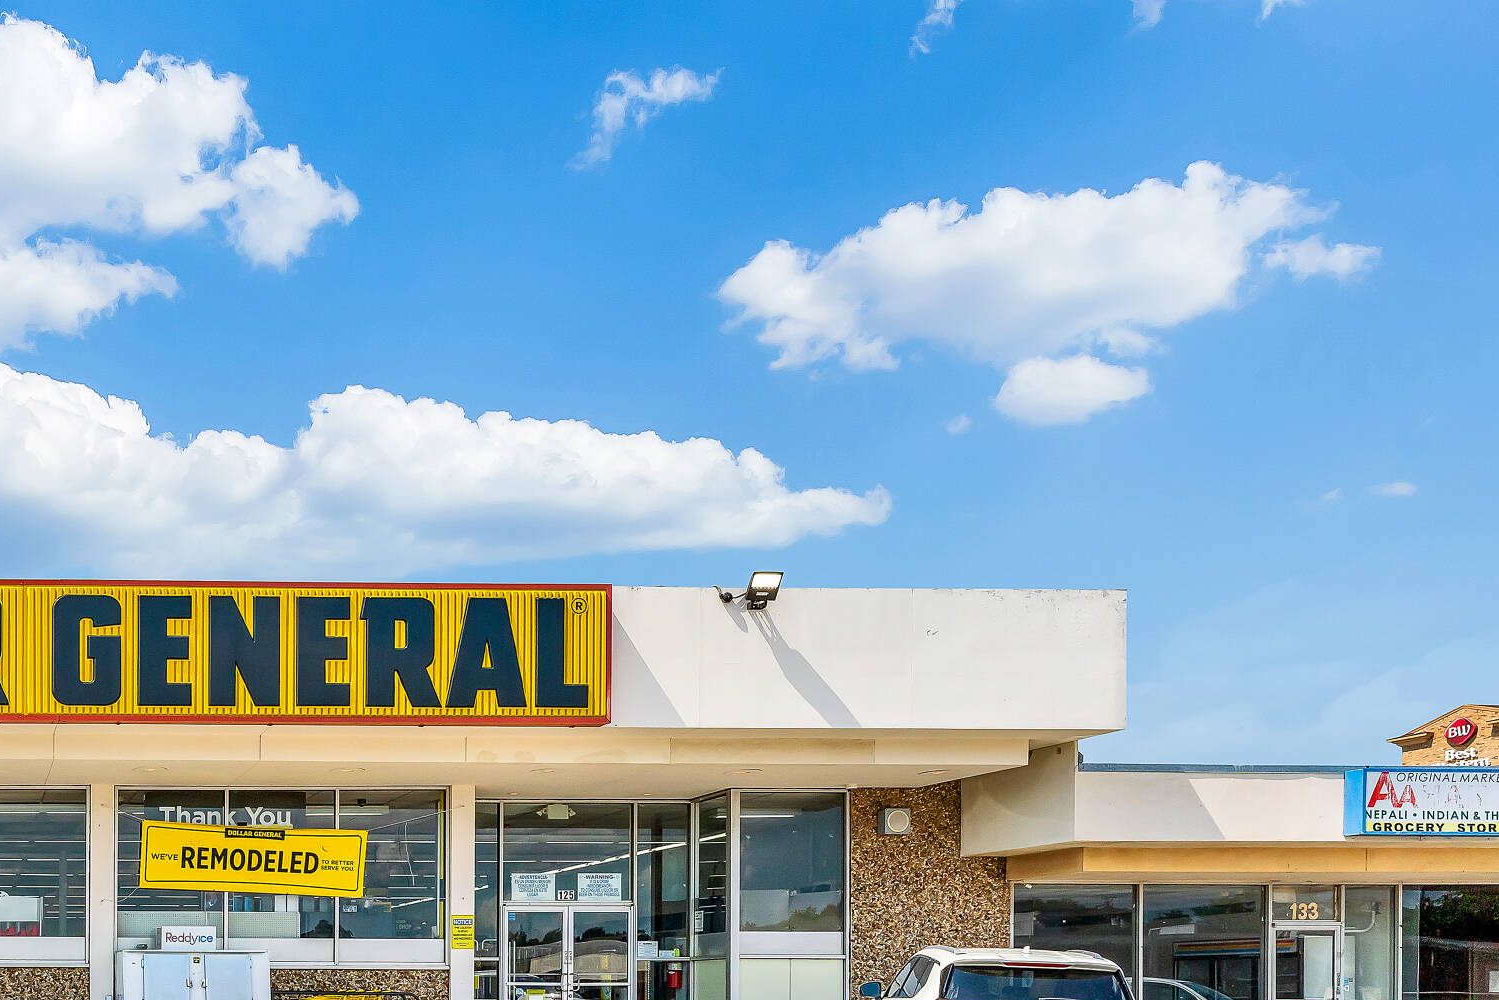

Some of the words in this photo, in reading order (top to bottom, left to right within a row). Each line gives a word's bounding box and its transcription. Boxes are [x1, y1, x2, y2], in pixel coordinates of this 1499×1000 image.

[52, 593, 589, 708] GENERAL
[1448, 724, 1471, 738] BW
[1445, 748, 1477, 761] Best
[1396, 772, 1457, 783] ORIGINAL
[159, 806, 237, 827] Thank
[245, 806, 293, 827] You
[1366, 810, 1408, 820] NEPALI
[1423, 811, 1469, 820] INDIAN
[1473, 811, 1481, 820] &
[227, 830, 253, 838] DOLLAR
[254, 831, 283, 839] GENERAL
[1373, 823, 1445, 832] GROCERY
[1458, 824, 1497, 833] STOR
[151, 852, 179, 861] WE'VE
[181, 846, 320, 875] REMODELED
[558, 891, 574, 900] 125
[1290, 902, 1319, 920] 133
